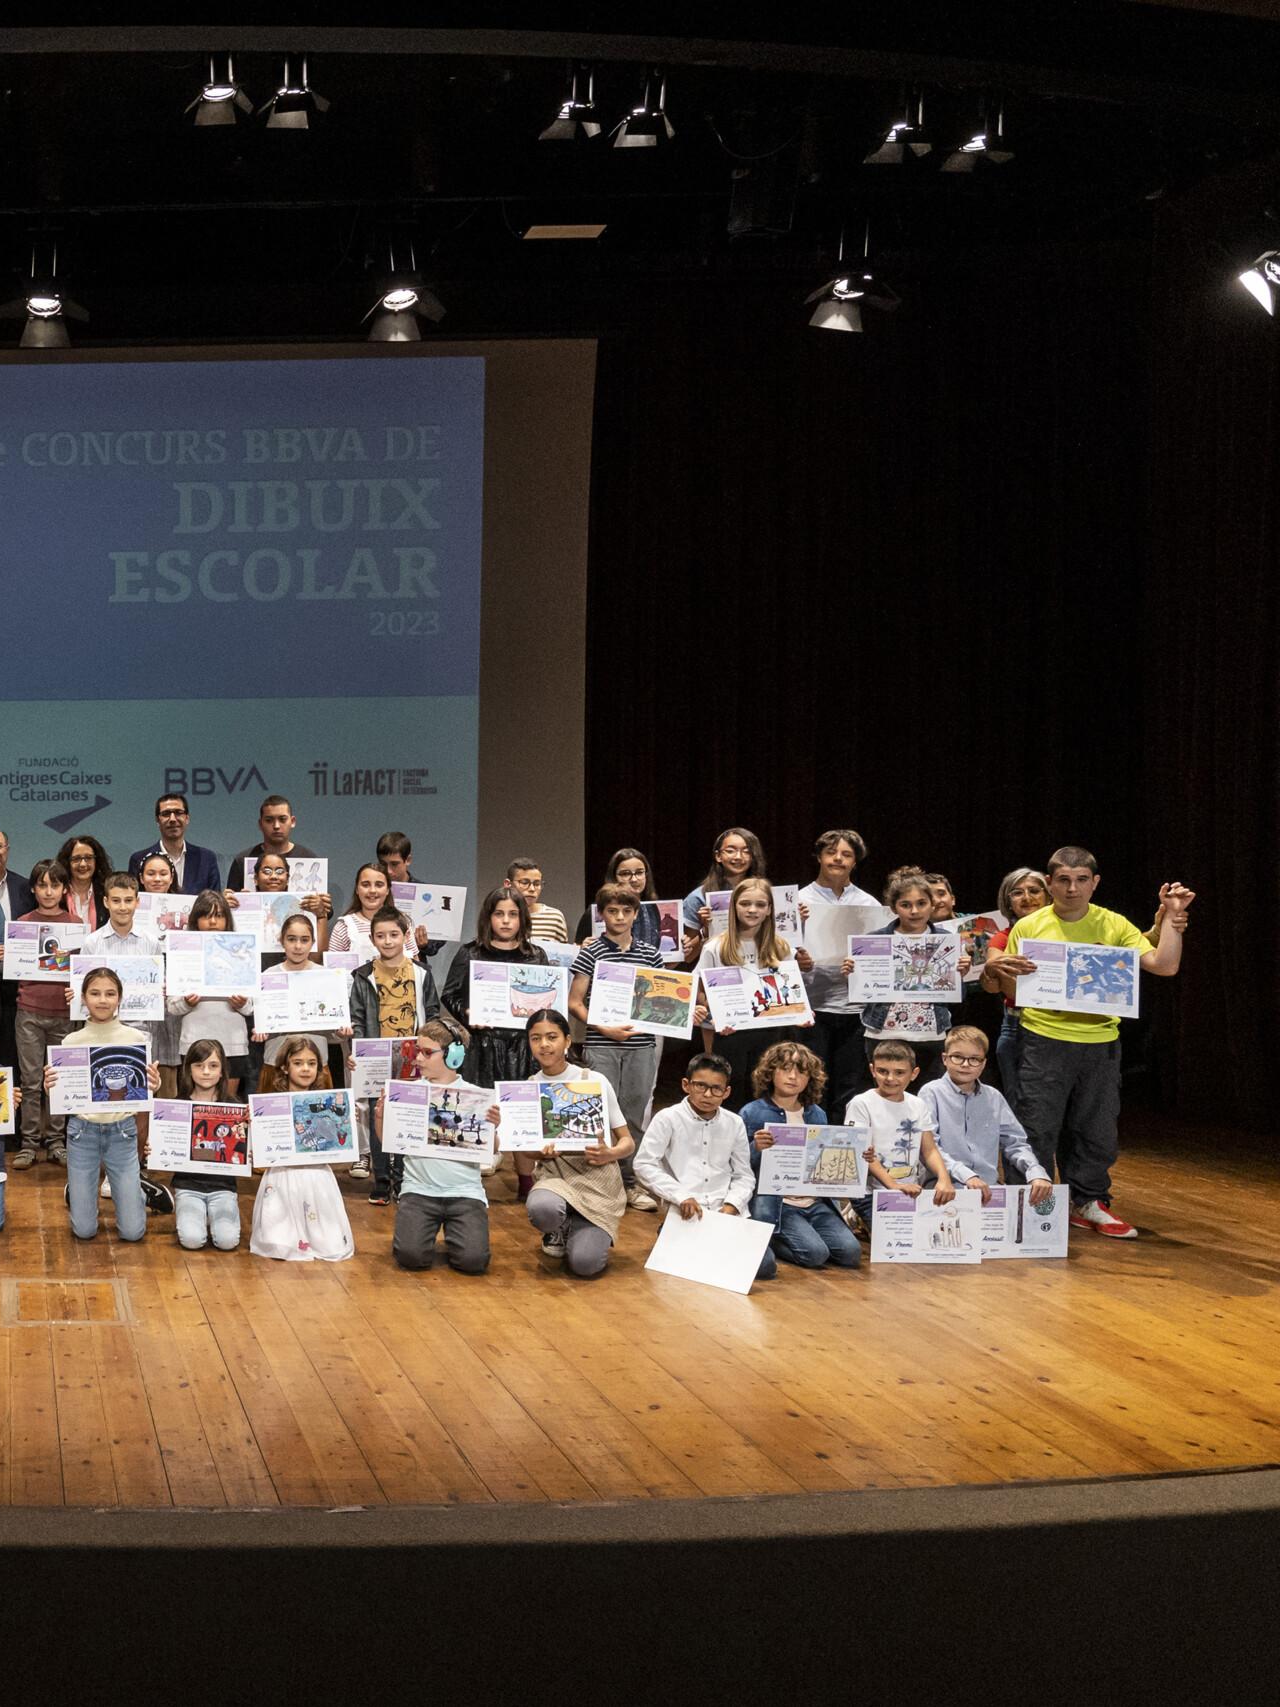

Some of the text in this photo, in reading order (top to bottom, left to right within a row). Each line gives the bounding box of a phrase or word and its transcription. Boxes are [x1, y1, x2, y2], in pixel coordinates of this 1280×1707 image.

[21, 429, 227, 467] CONCURS
[242, 427, 367, 465] BBVA
[384, 425, 441, 462] DE
[172, 478, 442, 535] DIBUIX
[107, 547, 441, 604] ESCOLAR
[369, 611, 440, 636] 2023
[9, 788, 89, 801] Catalanes
[164, 764, 269, 796] BBVA
